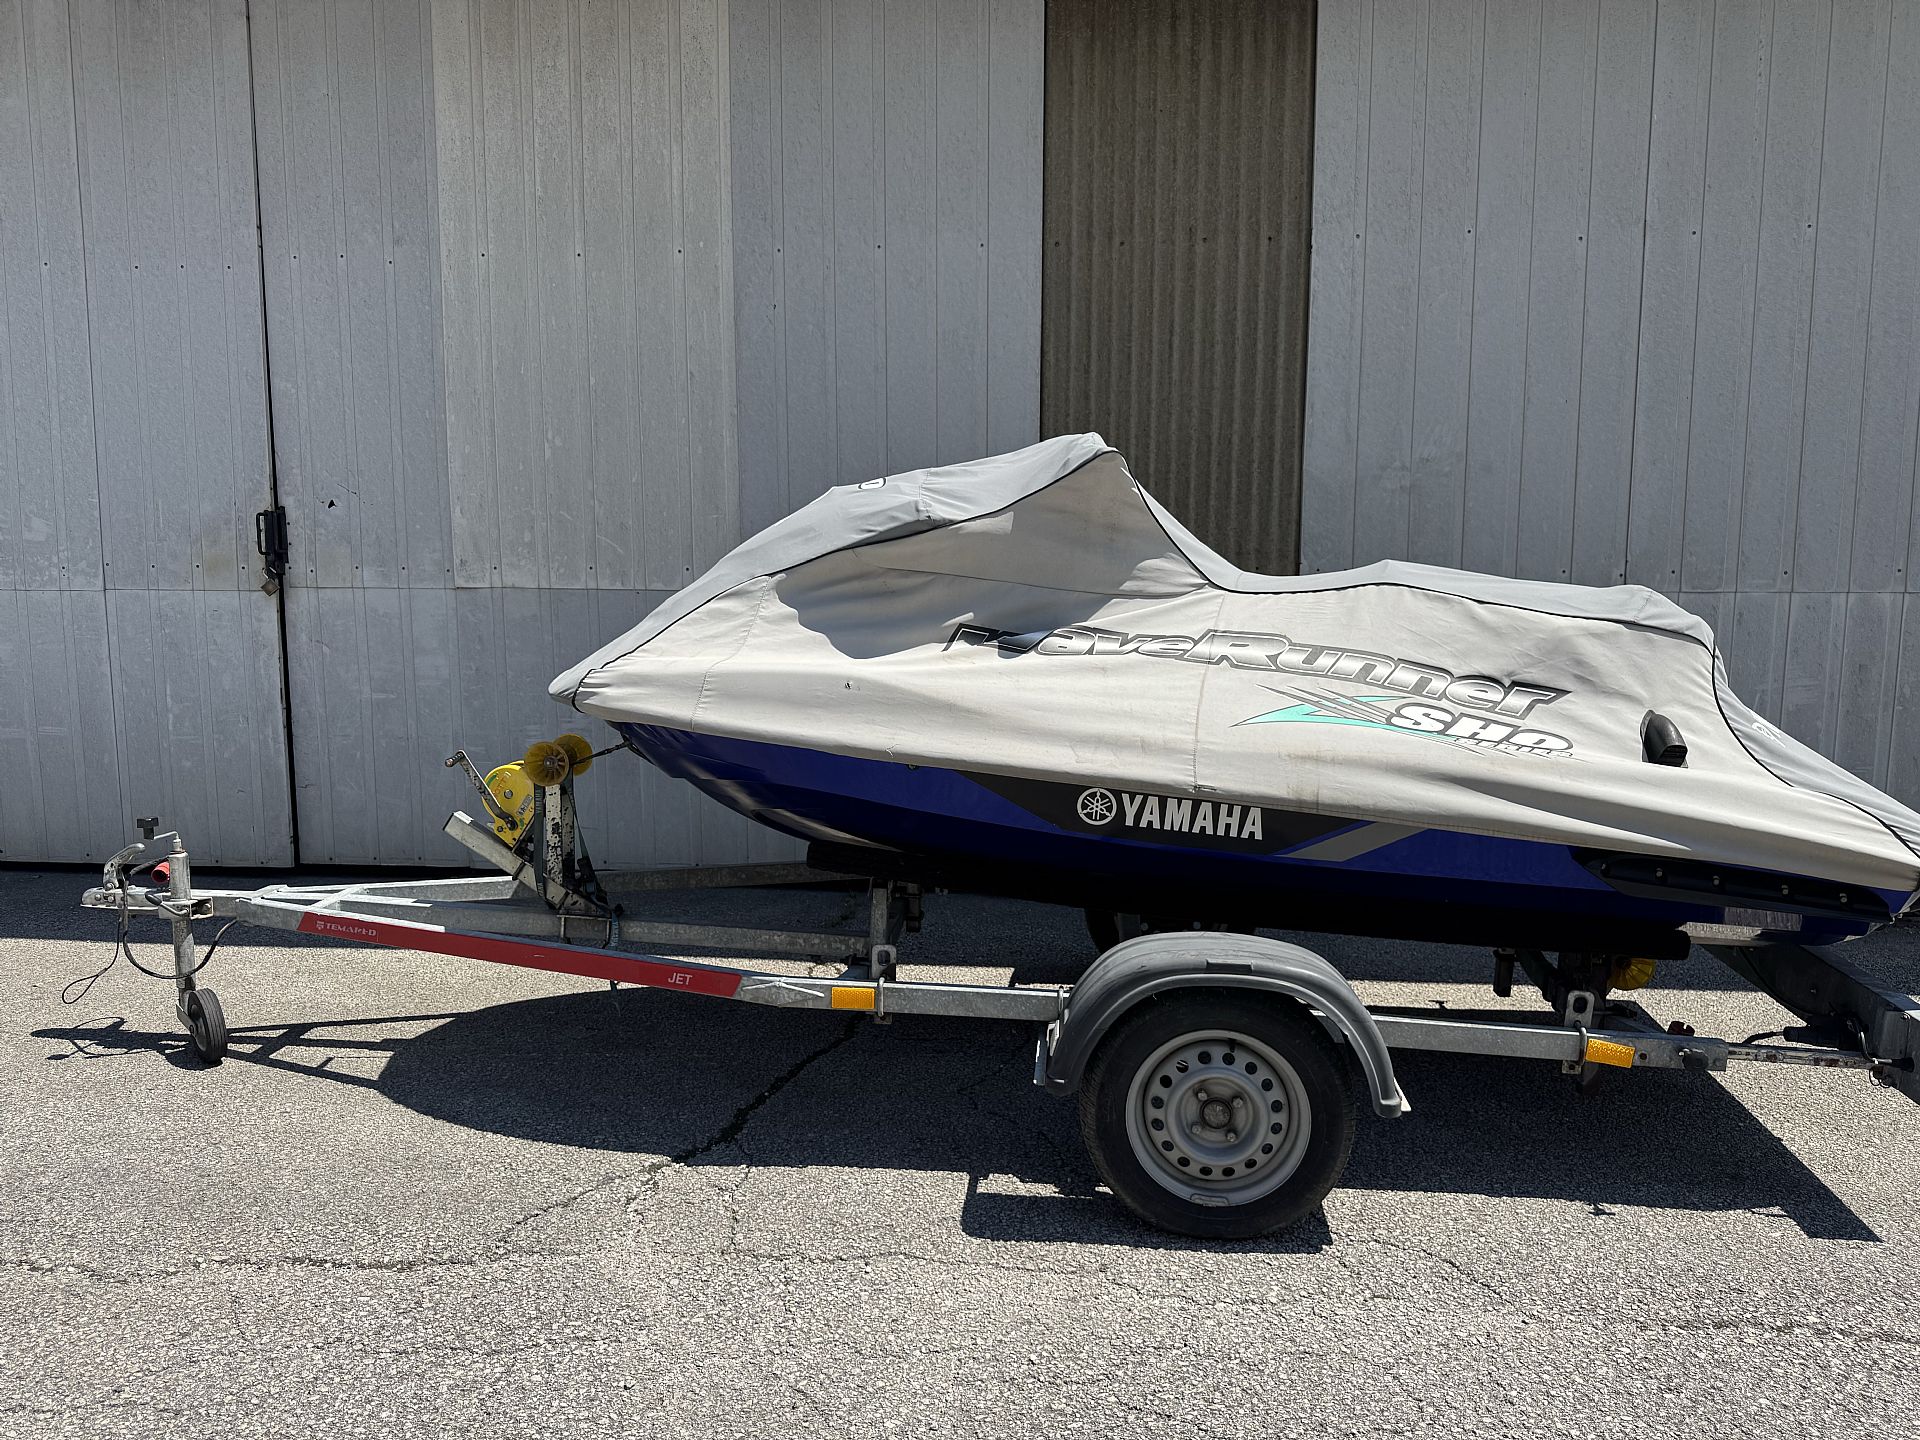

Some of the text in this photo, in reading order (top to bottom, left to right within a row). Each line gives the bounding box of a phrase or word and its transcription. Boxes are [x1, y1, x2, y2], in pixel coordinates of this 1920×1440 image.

[1385, 702, 1574, 751] SHO
[1121, 793, 1263, 840] YAMAHA
[668, 972, 693, 985] JET
